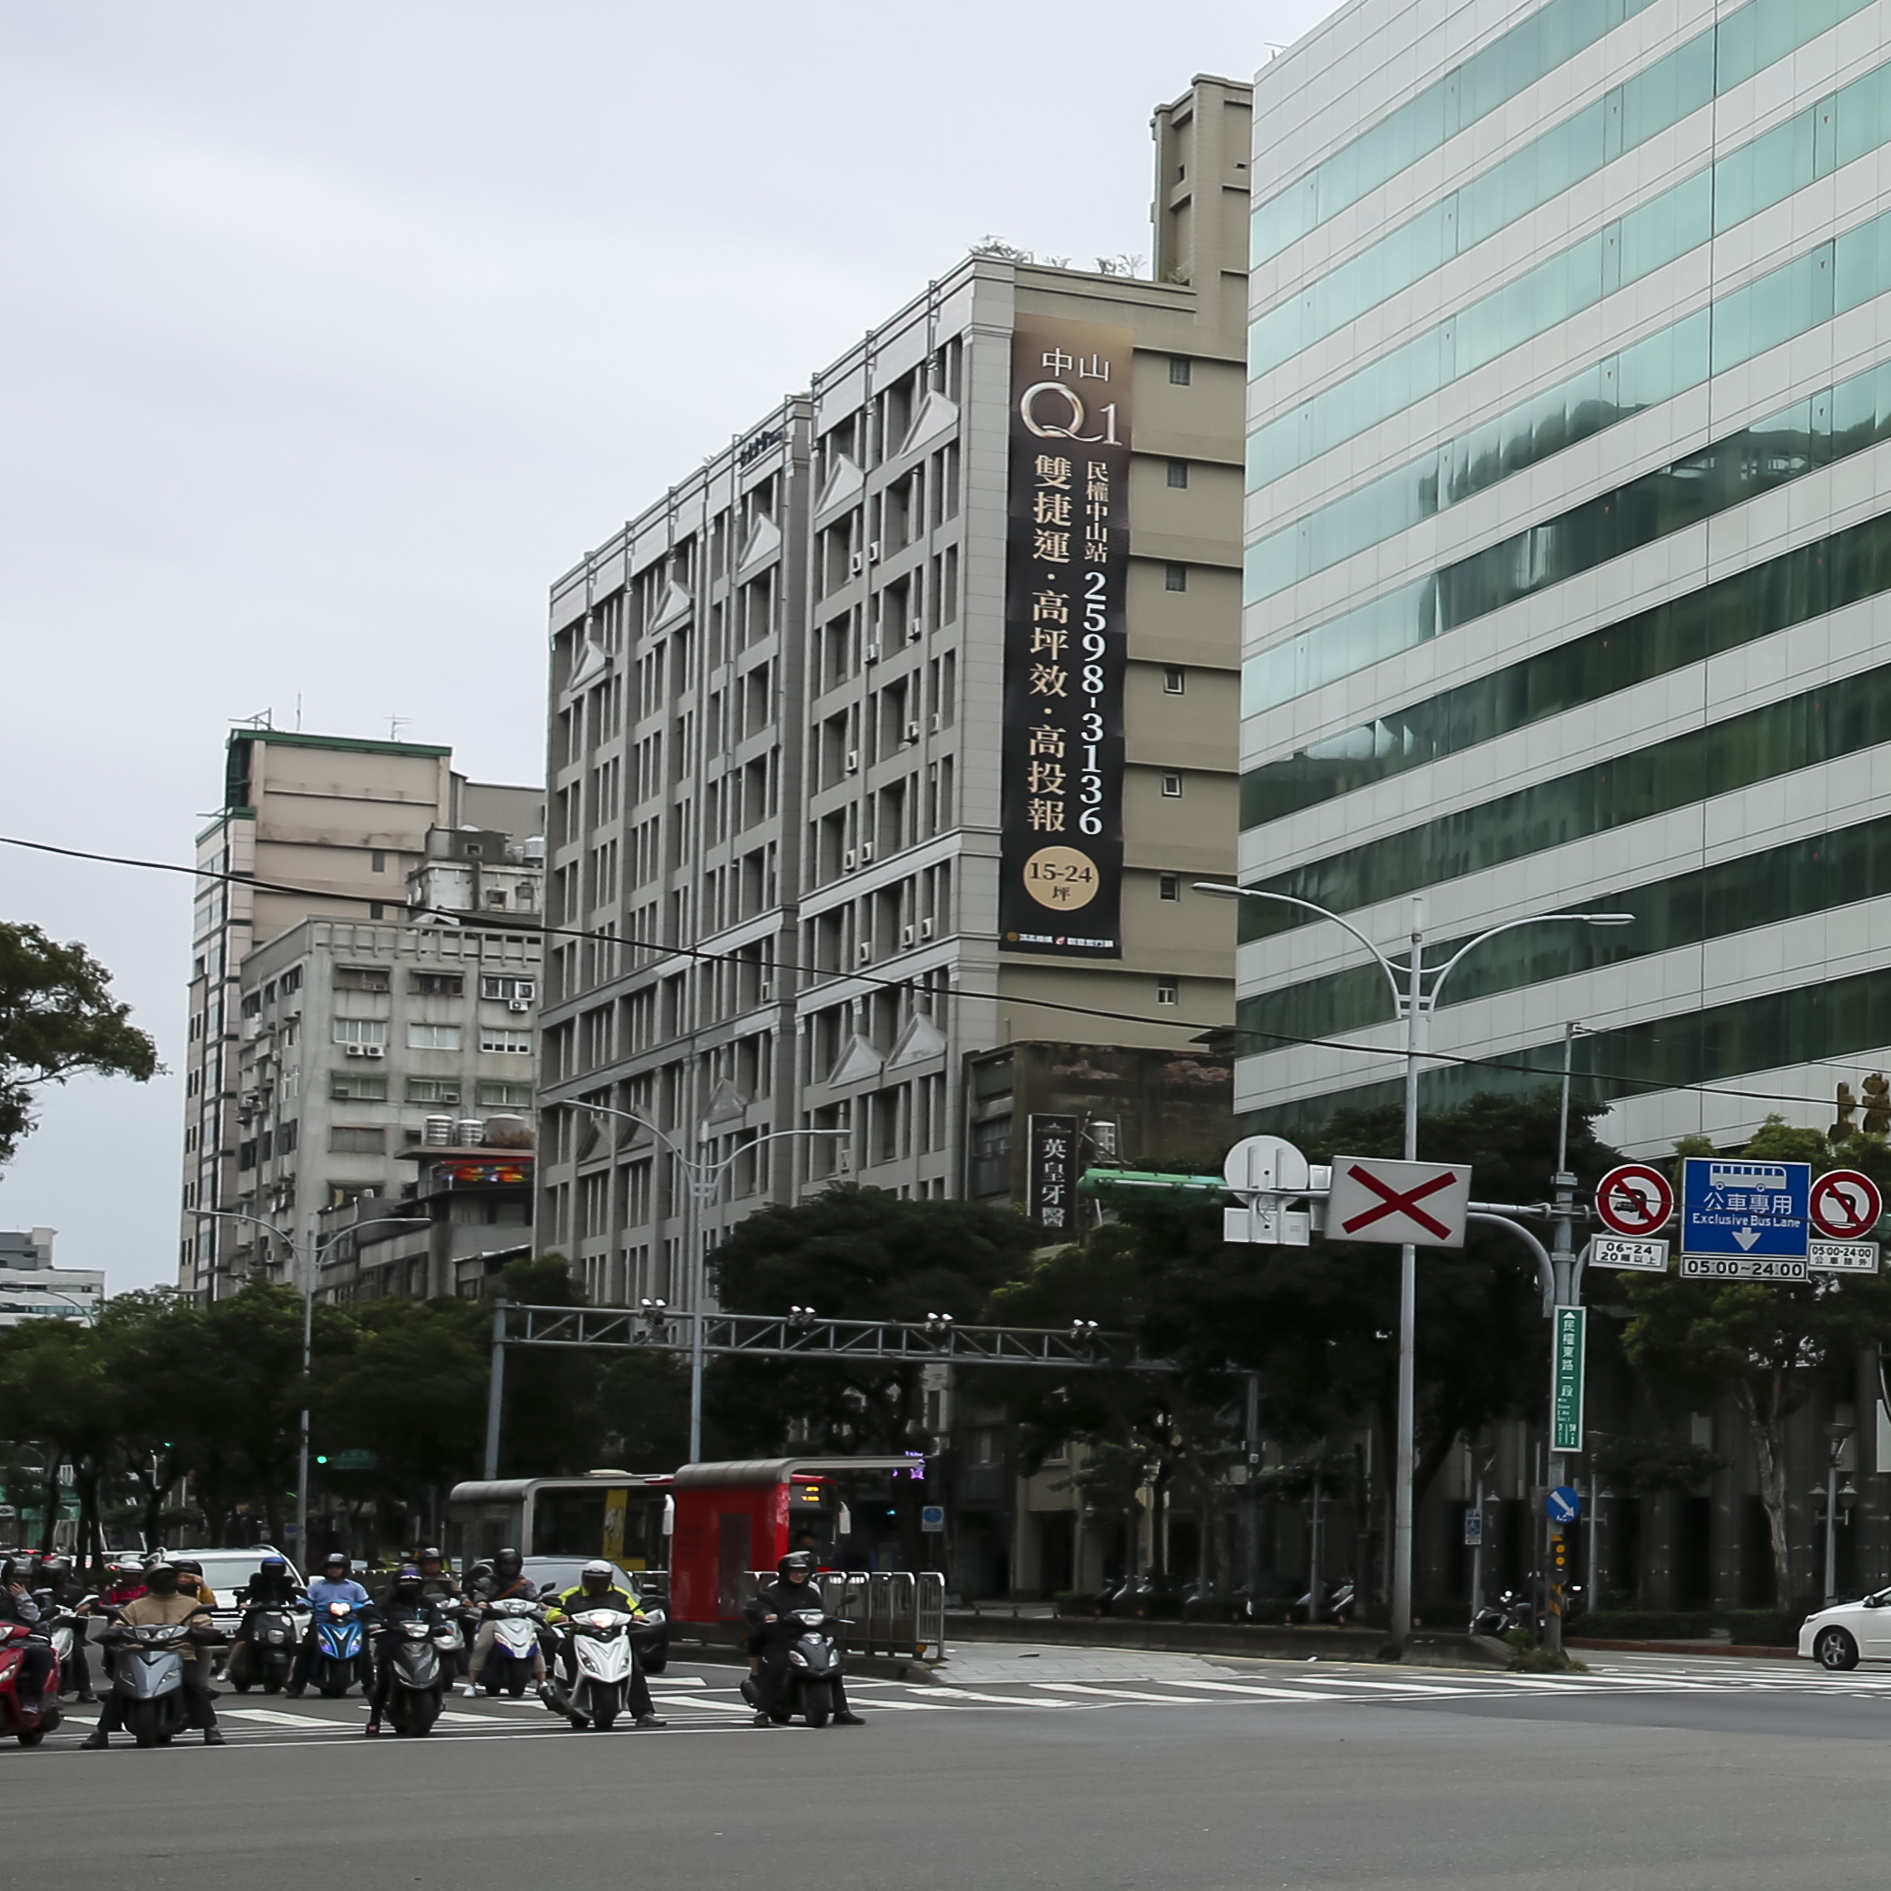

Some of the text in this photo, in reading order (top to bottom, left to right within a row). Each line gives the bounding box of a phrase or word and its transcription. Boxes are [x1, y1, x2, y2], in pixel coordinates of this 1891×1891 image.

[1042, 348, 1110, 382] 中山
[1020, 382, 1122, 446] Q1
[1083, 461, 1109, 563] 民權中山站
[1079, 571, 1107, 835] 2598-3136
[1030, 862, 1092, 883] 15-24
[1051, 885, 1070, 902] 坪
[1704, 1192, 1792, 1215] 公車專用
[1693, 1213, 1800, 1228] Exclusive Bus Lane
[1606, 1242, 1652, 1255] 06-24
[1561, 1320, 1575, 1397] 民權東路一段
